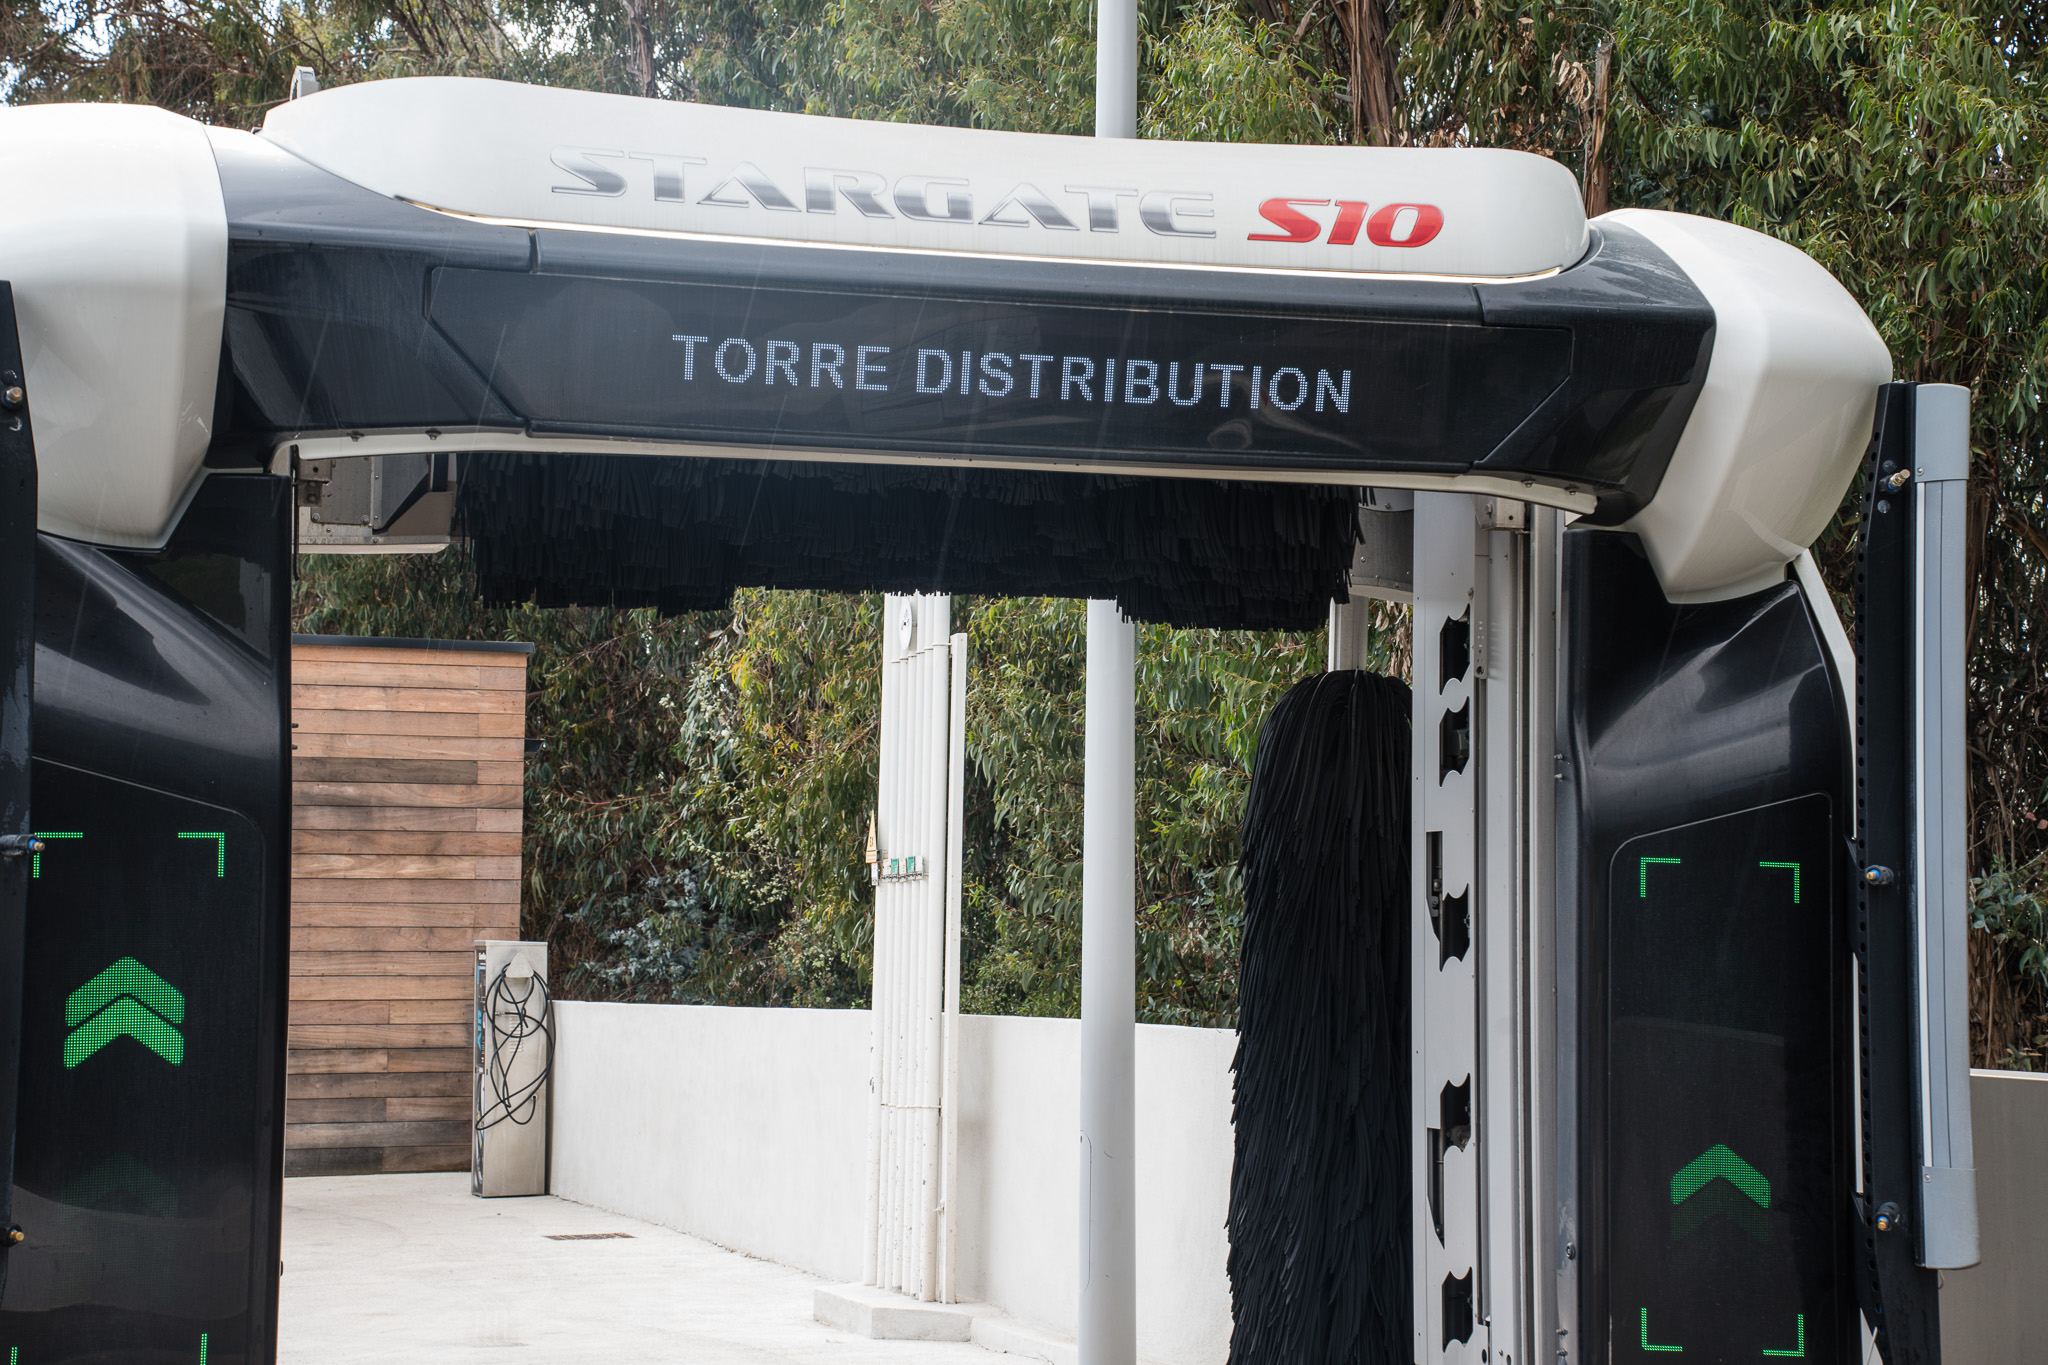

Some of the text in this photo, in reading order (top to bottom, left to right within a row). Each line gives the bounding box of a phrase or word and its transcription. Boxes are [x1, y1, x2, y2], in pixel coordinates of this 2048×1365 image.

[550, 146, 1444, 248] STARGATE S10
[672, 334, 1351, 413] TORRE DISTRIBUTION
